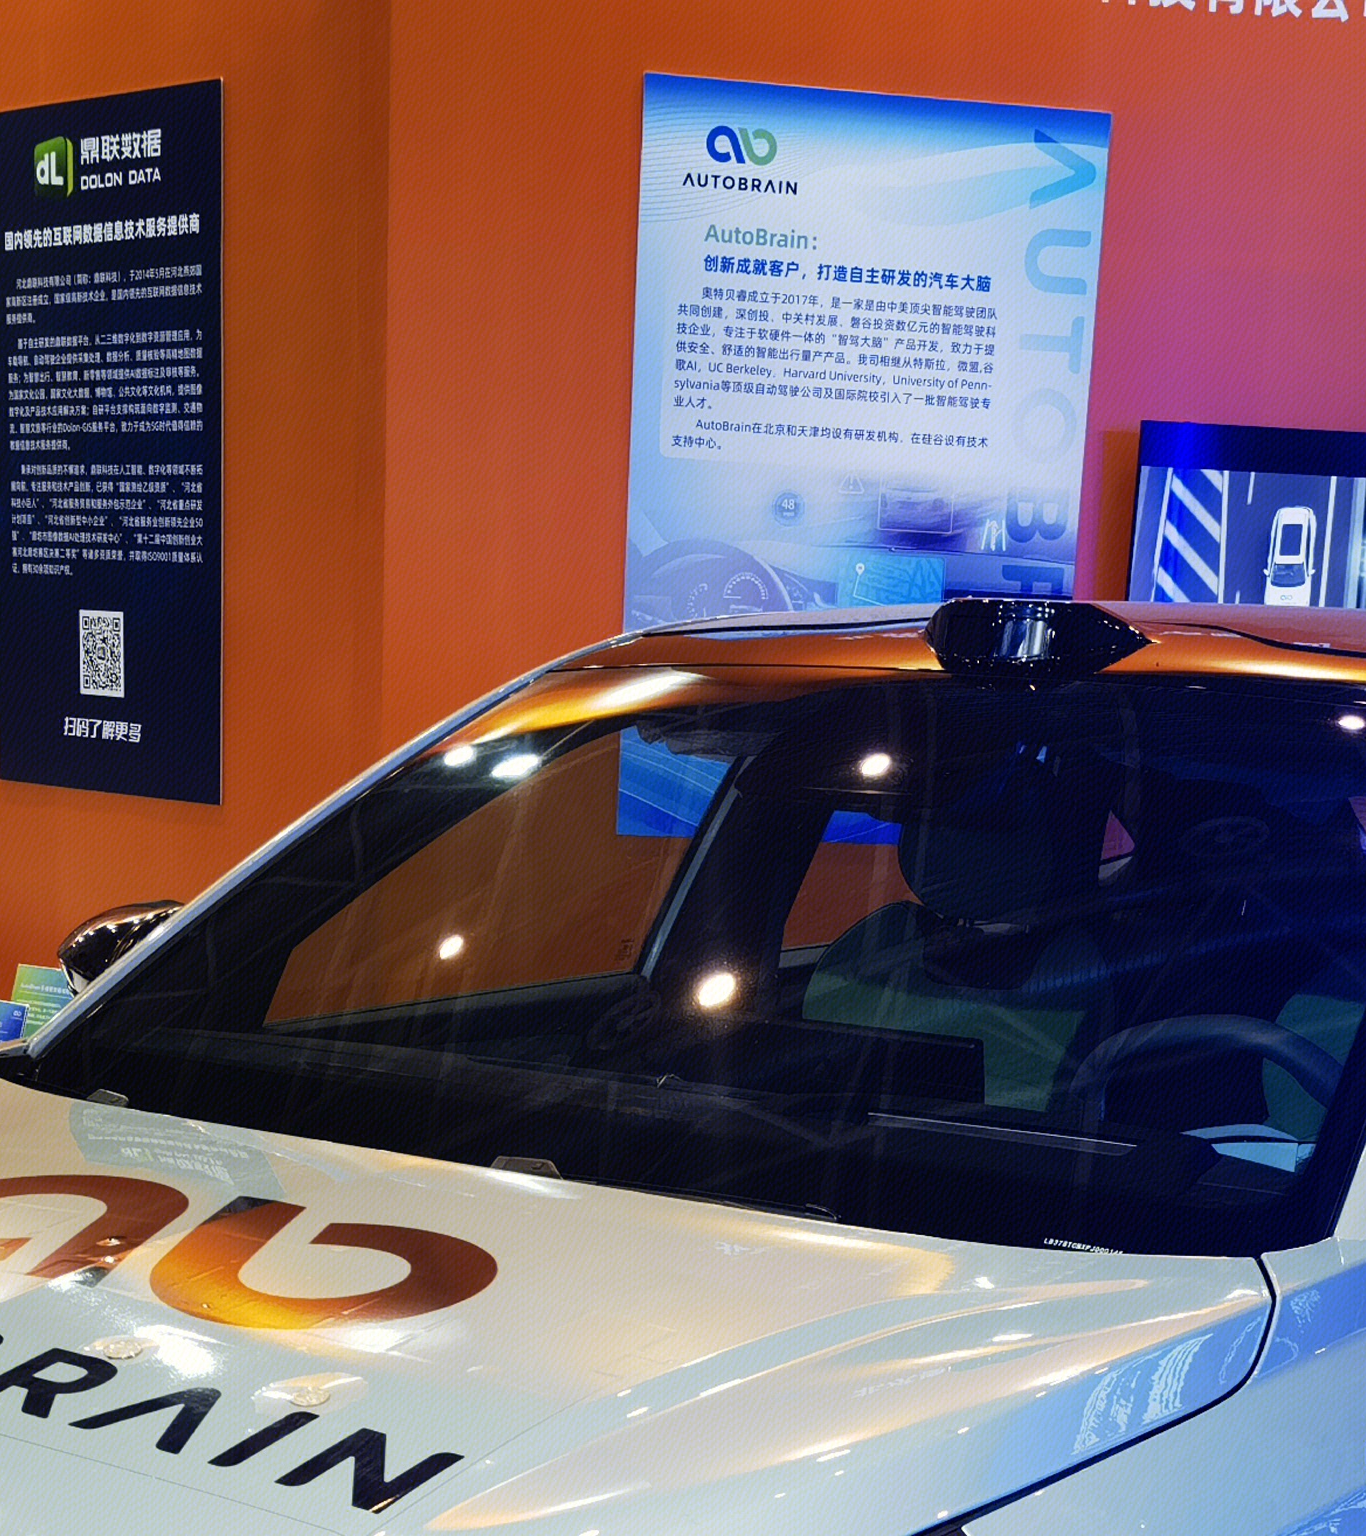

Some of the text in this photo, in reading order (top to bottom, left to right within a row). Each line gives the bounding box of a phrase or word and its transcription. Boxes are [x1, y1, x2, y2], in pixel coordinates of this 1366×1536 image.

[80, 128, 162, 166] 鼎联数据
[80, 167, 162, 191] DOLON DATA
[682, 171, 799, 197] AUTOBRAIN
[4, 212, 200, 252] 国内领先的互联网数据信息技术服务提供商
[703, 254, 992, 293] 创新成就客户，打造自主研发的汽车大脑
[708, 361, 724, 373] UC
[783, 367, 827, 381] Harvard
[892, 374, 946, 391] University
[947, 377, 960, 389] of
[672, 395, 713, 410] 业人才。
[63, 715, 143, 744] 扫码了解更多
